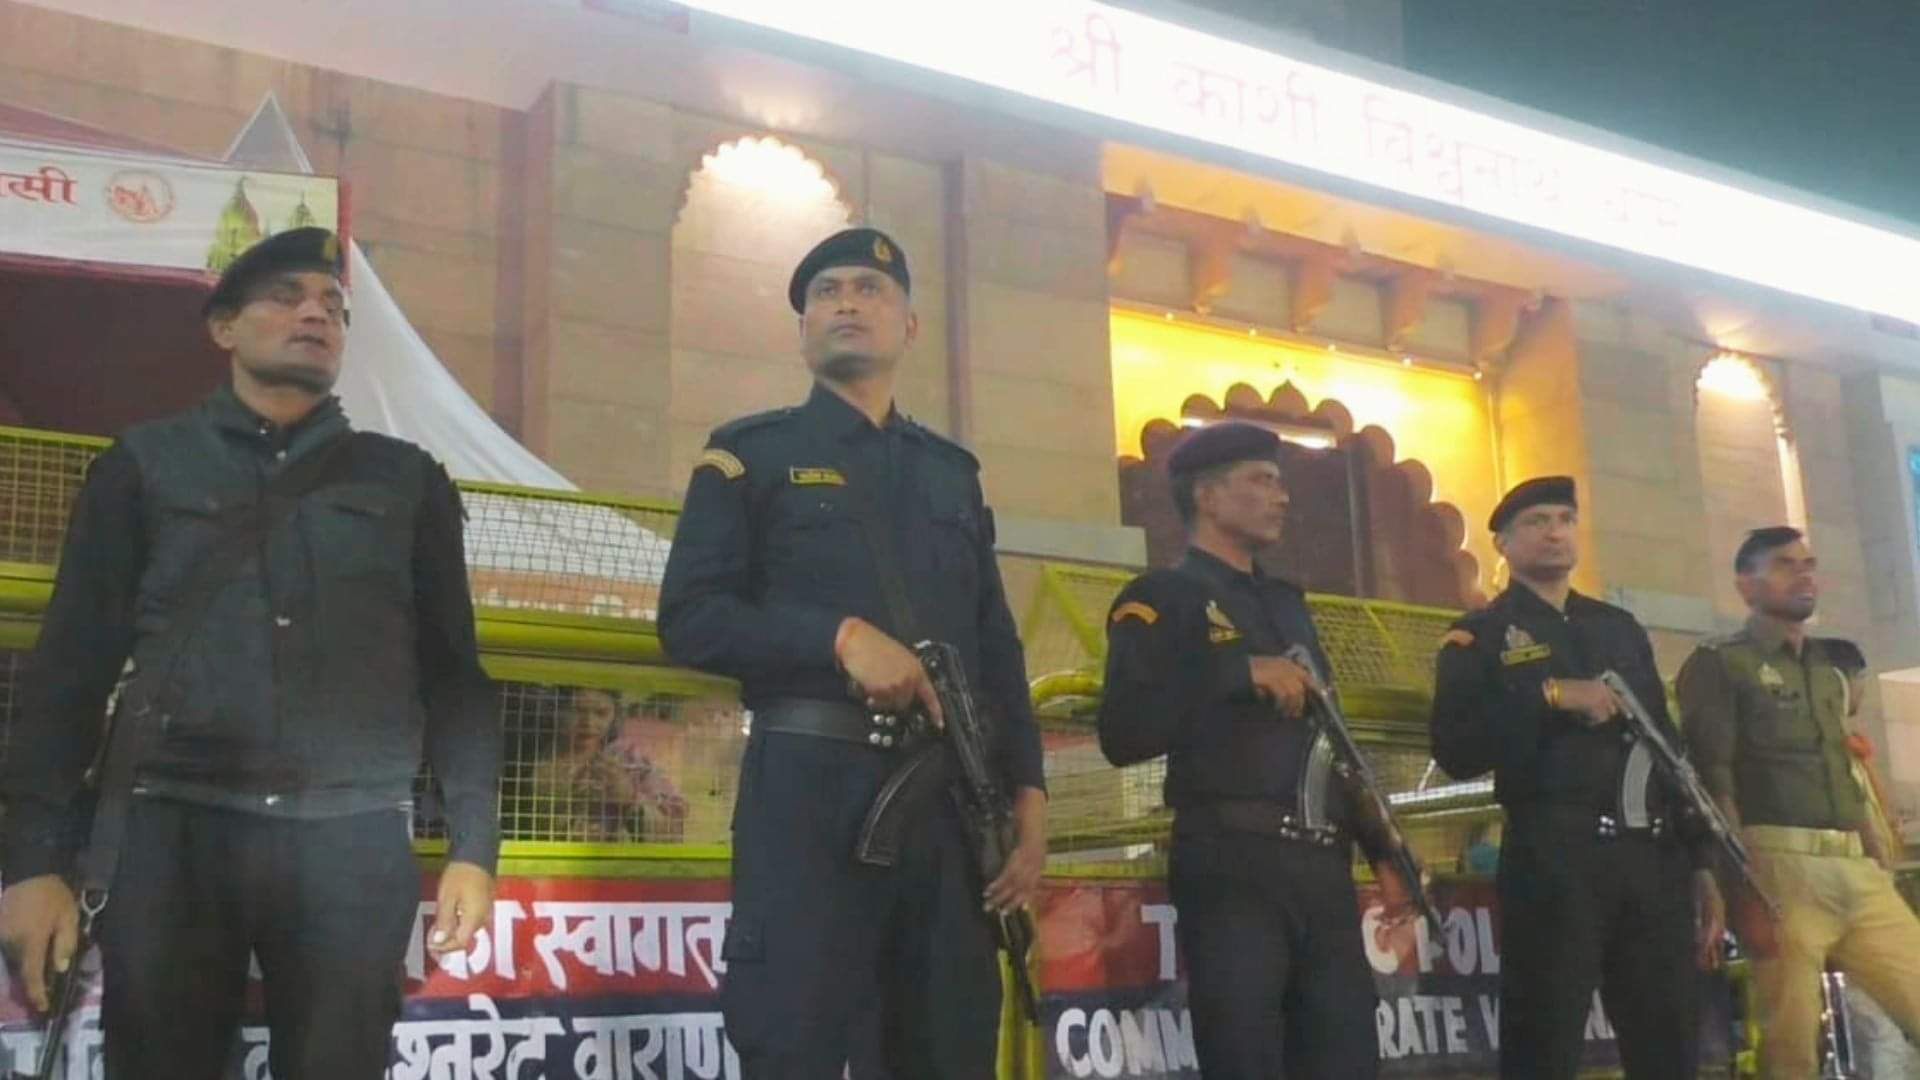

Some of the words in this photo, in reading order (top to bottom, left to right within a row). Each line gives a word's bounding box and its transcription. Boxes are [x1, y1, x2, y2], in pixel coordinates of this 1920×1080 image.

[1048, 12, 1122, 97] श्री
[1172, 61, 1320, 146] काशी
[533, 901, 733, 989] स्वागत
[573, 1011, 741, 1080] वाराण
[1056, 1008, 1199, 1078] COMM
[1375, 994, 1468, 1060] RATE
